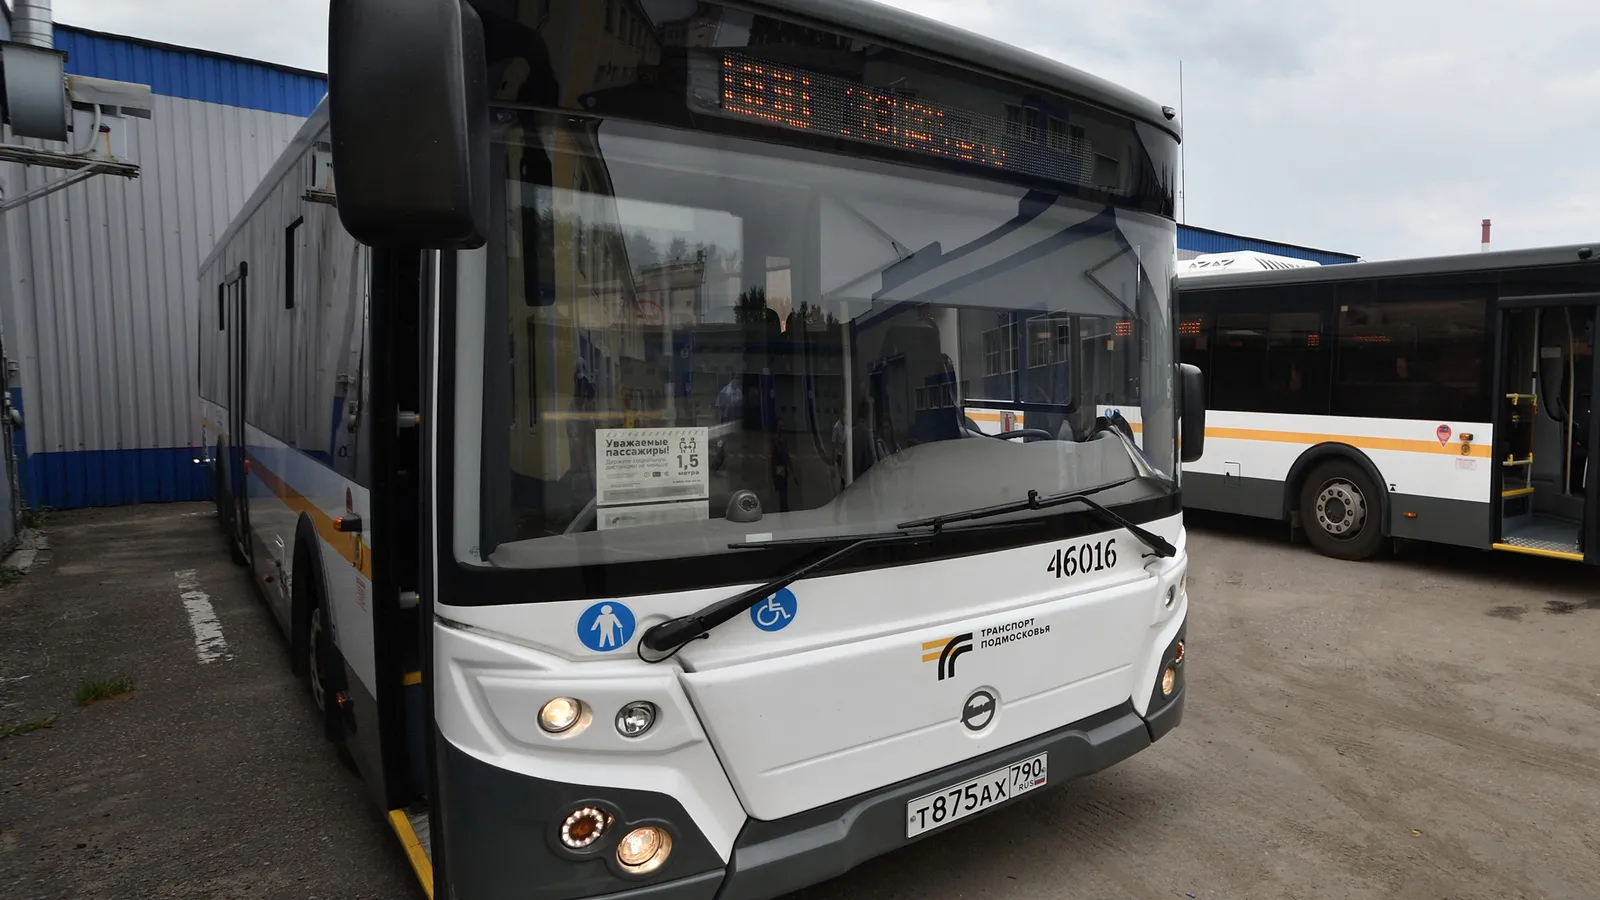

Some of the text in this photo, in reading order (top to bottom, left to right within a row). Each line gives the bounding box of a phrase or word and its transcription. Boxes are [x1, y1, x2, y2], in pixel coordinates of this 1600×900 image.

[606, 439, 668, 448] Уважаемые
[606, 446, 669, 457] пассажиры!
[677, 454, 699, 470] 1,5
[1047, 538, 1117, 578] 46016
[981, 618, 1035, 637] ТРАНСПОРТ
[981, 625, 1050, 649] ПОДМОСКОВЬЯ
[916, 758, 1042, 829] Т875АХ 790
[1019, 780, 1034, 791] RUS
